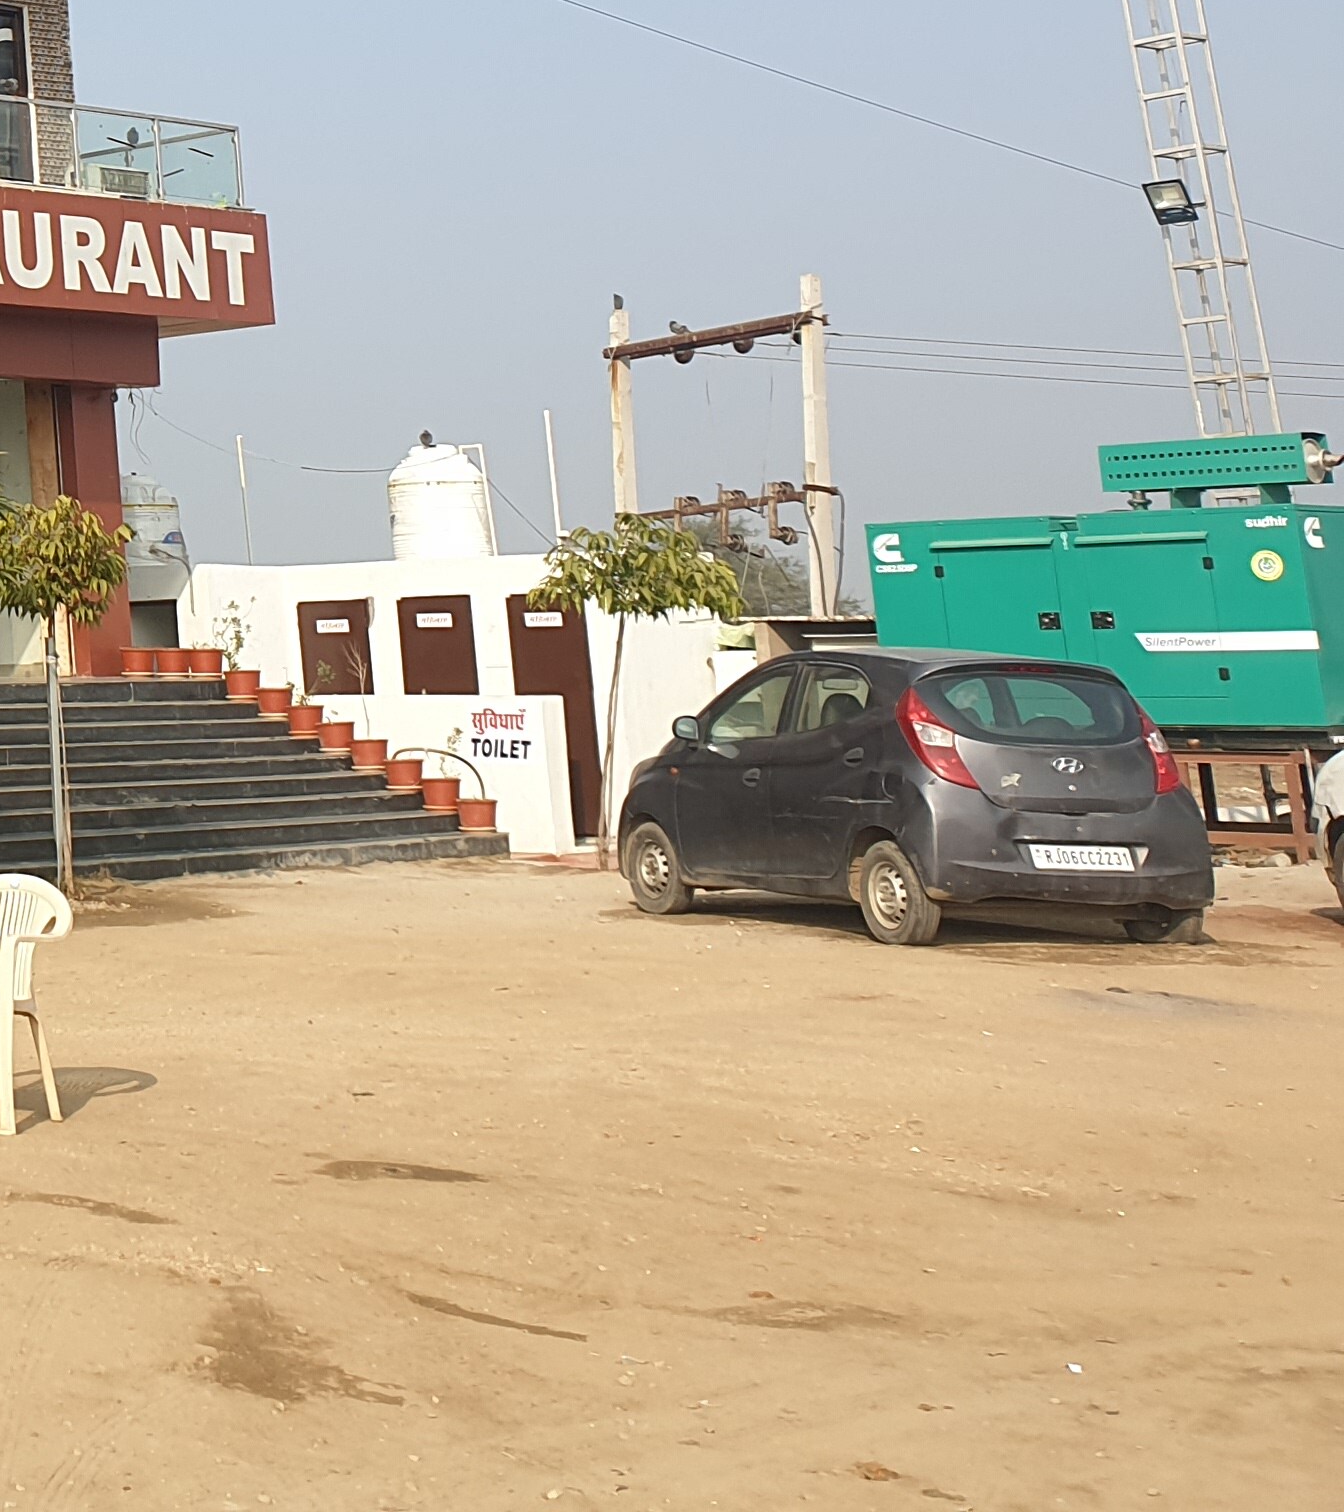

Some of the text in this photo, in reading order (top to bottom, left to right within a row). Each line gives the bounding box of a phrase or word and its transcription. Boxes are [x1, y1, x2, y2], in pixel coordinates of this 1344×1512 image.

[1244, 515, 1289, 528] sudhir
[1144, 635, 1218, 649] SilentPower
[470, 738, 532, 760] TOILET
[1045, 848, 1130, 867] RJ06CC2231
